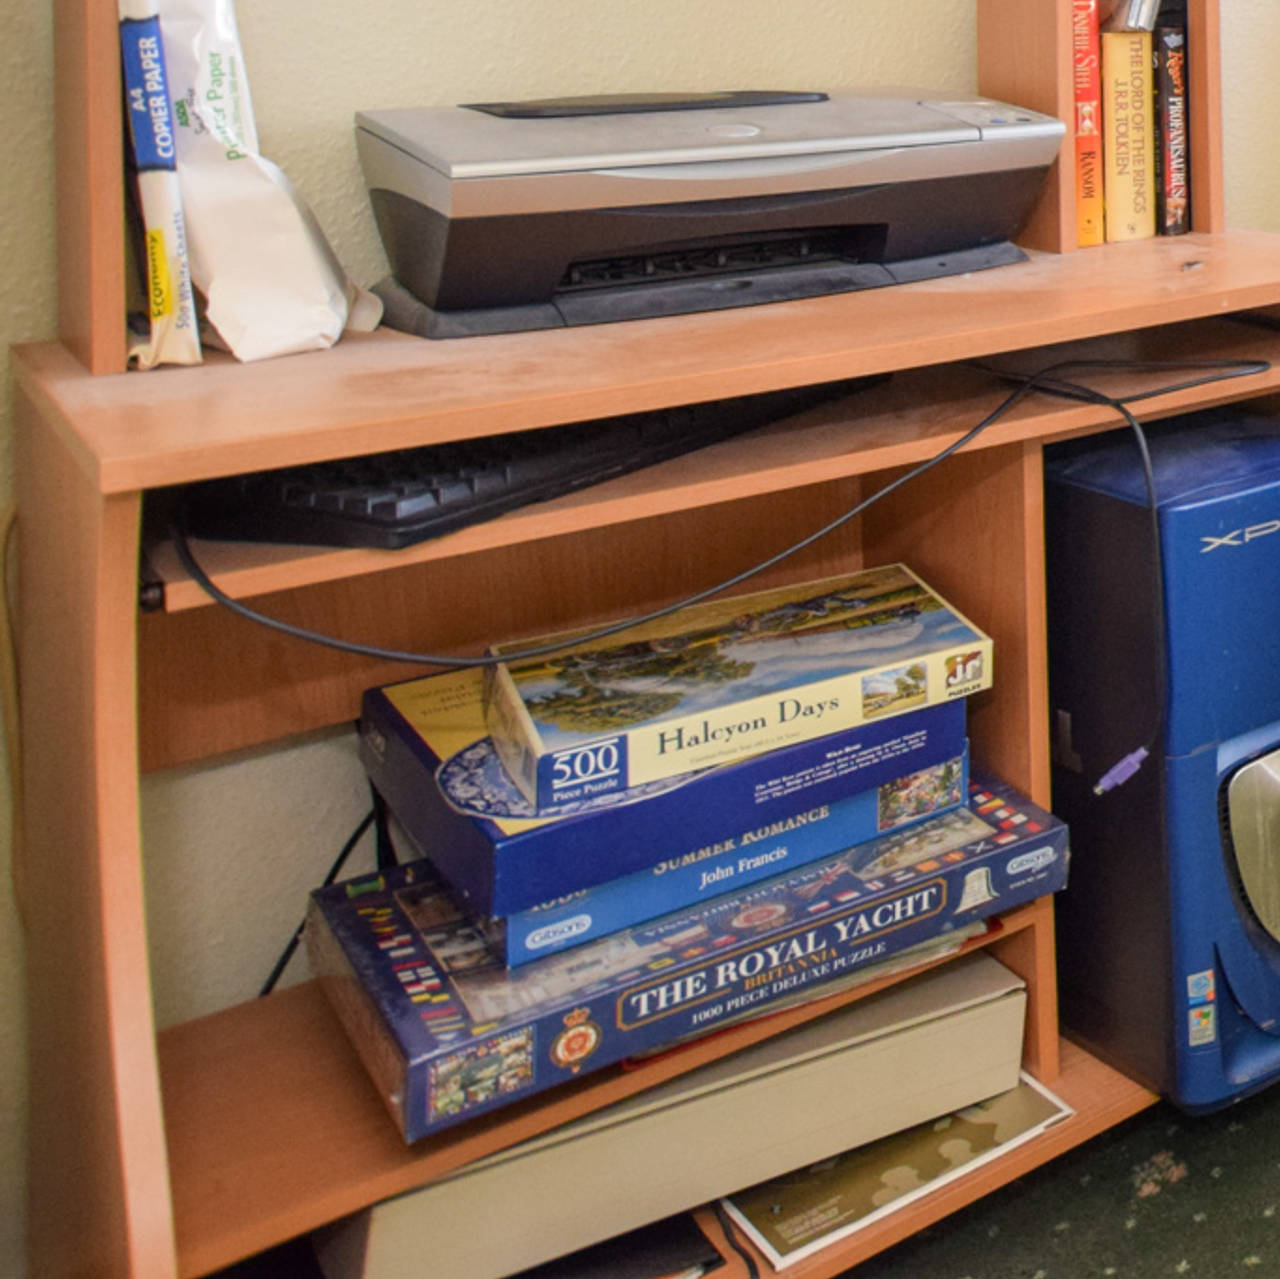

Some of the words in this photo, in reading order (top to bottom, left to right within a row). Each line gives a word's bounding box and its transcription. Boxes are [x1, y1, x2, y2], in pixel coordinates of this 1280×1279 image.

[138, 36, 164, 92] PAPER
[1130, 38, 1143, 68] THE
[206, 51, 226, 101] Paper
[1131, 69, 1144, 111] LORD
[130, 87, 147, 112] A4
[174, 98, 190, 128] ASDA
[148, 95, 174, 159] COPIER
[1131, 112, 1144, 133] OF
[1115, 115, 1130, 176] TOLKIEN
[1132, 139, 1145, 167] THE
[1167, 97, 1186, 199] PROFANISAURUS
[1080, 151, 1096, 198] RANSOM
[1132, 168, 1147, 215] RINGS
[658, 717, 767, 755] Halcyon
[778, 697, 839, 723] Days
[553, 744, 618, 786] 500
[553, 789, 581, 802] Piece
[584, 778, 618, 794] Puzzle
[653, 839, 736, 876] SUMMER
[741, 805, 830, 846] ROMANCE
[699, 865, 734, 890] John
[738, 846, 788, 873] Francis
[530, 920, 588, 946] Gibsons
[630, 971, 707, 1018] THE
[716, 931, 826, 989] ROYAL
[834, 887, 937, 943] YACHT
[692, 1004, 723, 1025] 1000
[727, 988, 769, 1011] PIECE
[772, 963, 830, 994] DELUXE
[833, 941, 886, 970] PUZZLE
[744, 948, 838, 991] BRITANNIA
